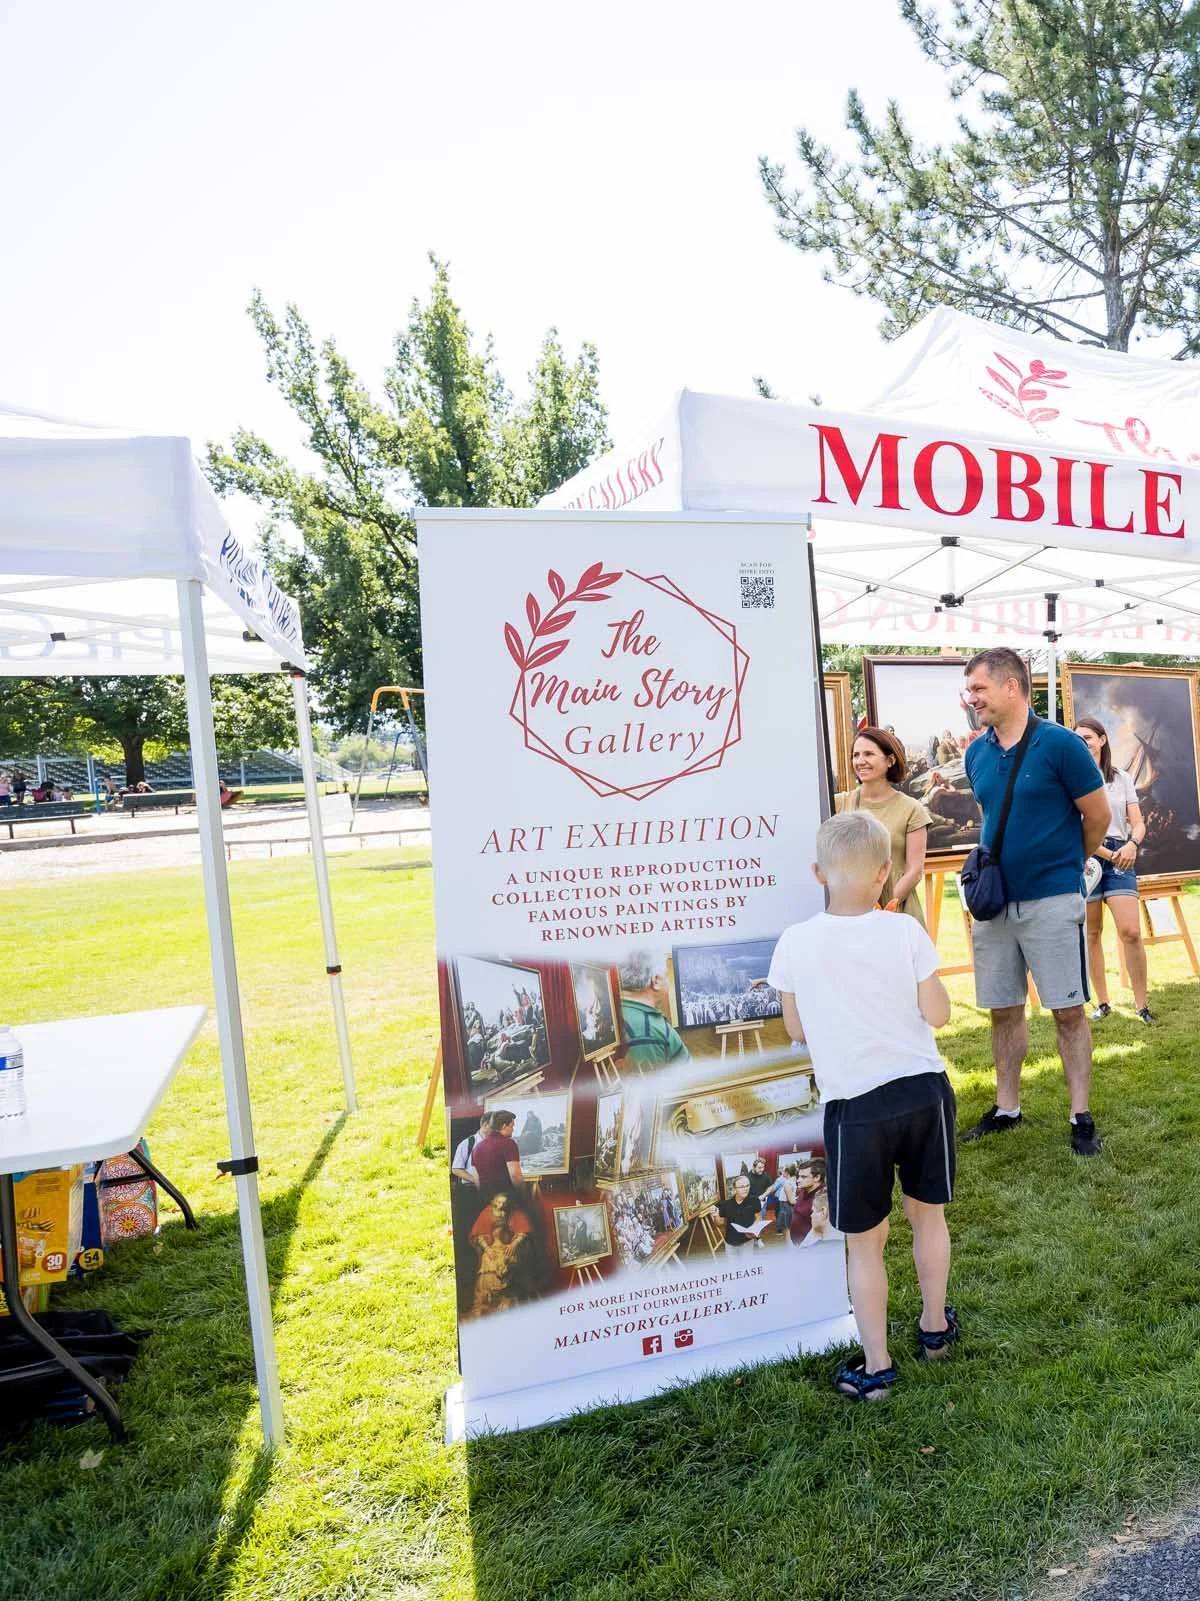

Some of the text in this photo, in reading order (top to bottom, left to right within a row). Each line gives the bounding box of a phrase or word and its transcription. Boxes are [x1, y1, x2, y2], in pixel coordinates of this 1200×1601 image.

[809, 423, 1185, 540] MOBILE
[601, 609, 661, 658] The
[530, 668, 733, 720] Main Story
[565, 722, 705, 761] Gallery
[480, 814, 780, 854] ART EXHIBITION
[506, 857, 763, 885] A UNIQUE REPRODUCTION
[492, 874, 778, 906] COLLECTION OF WORLDWIDE
[527, 895, 748, 923] FAMOUS PAINTINGS BY
[541, 914, 737, 942] RENOWNED ARTISTS
[47, 1254, 63, 1267] 30
[84, 1250, 100, 1264] 54
[559, 1266, 765, 1315] FOR MORE INFORMATION PLEASE
[553, 1292, 770, 1351] MAINSTORYGALLERY.ART
[606, 1303, 640, 1319] VISIT
